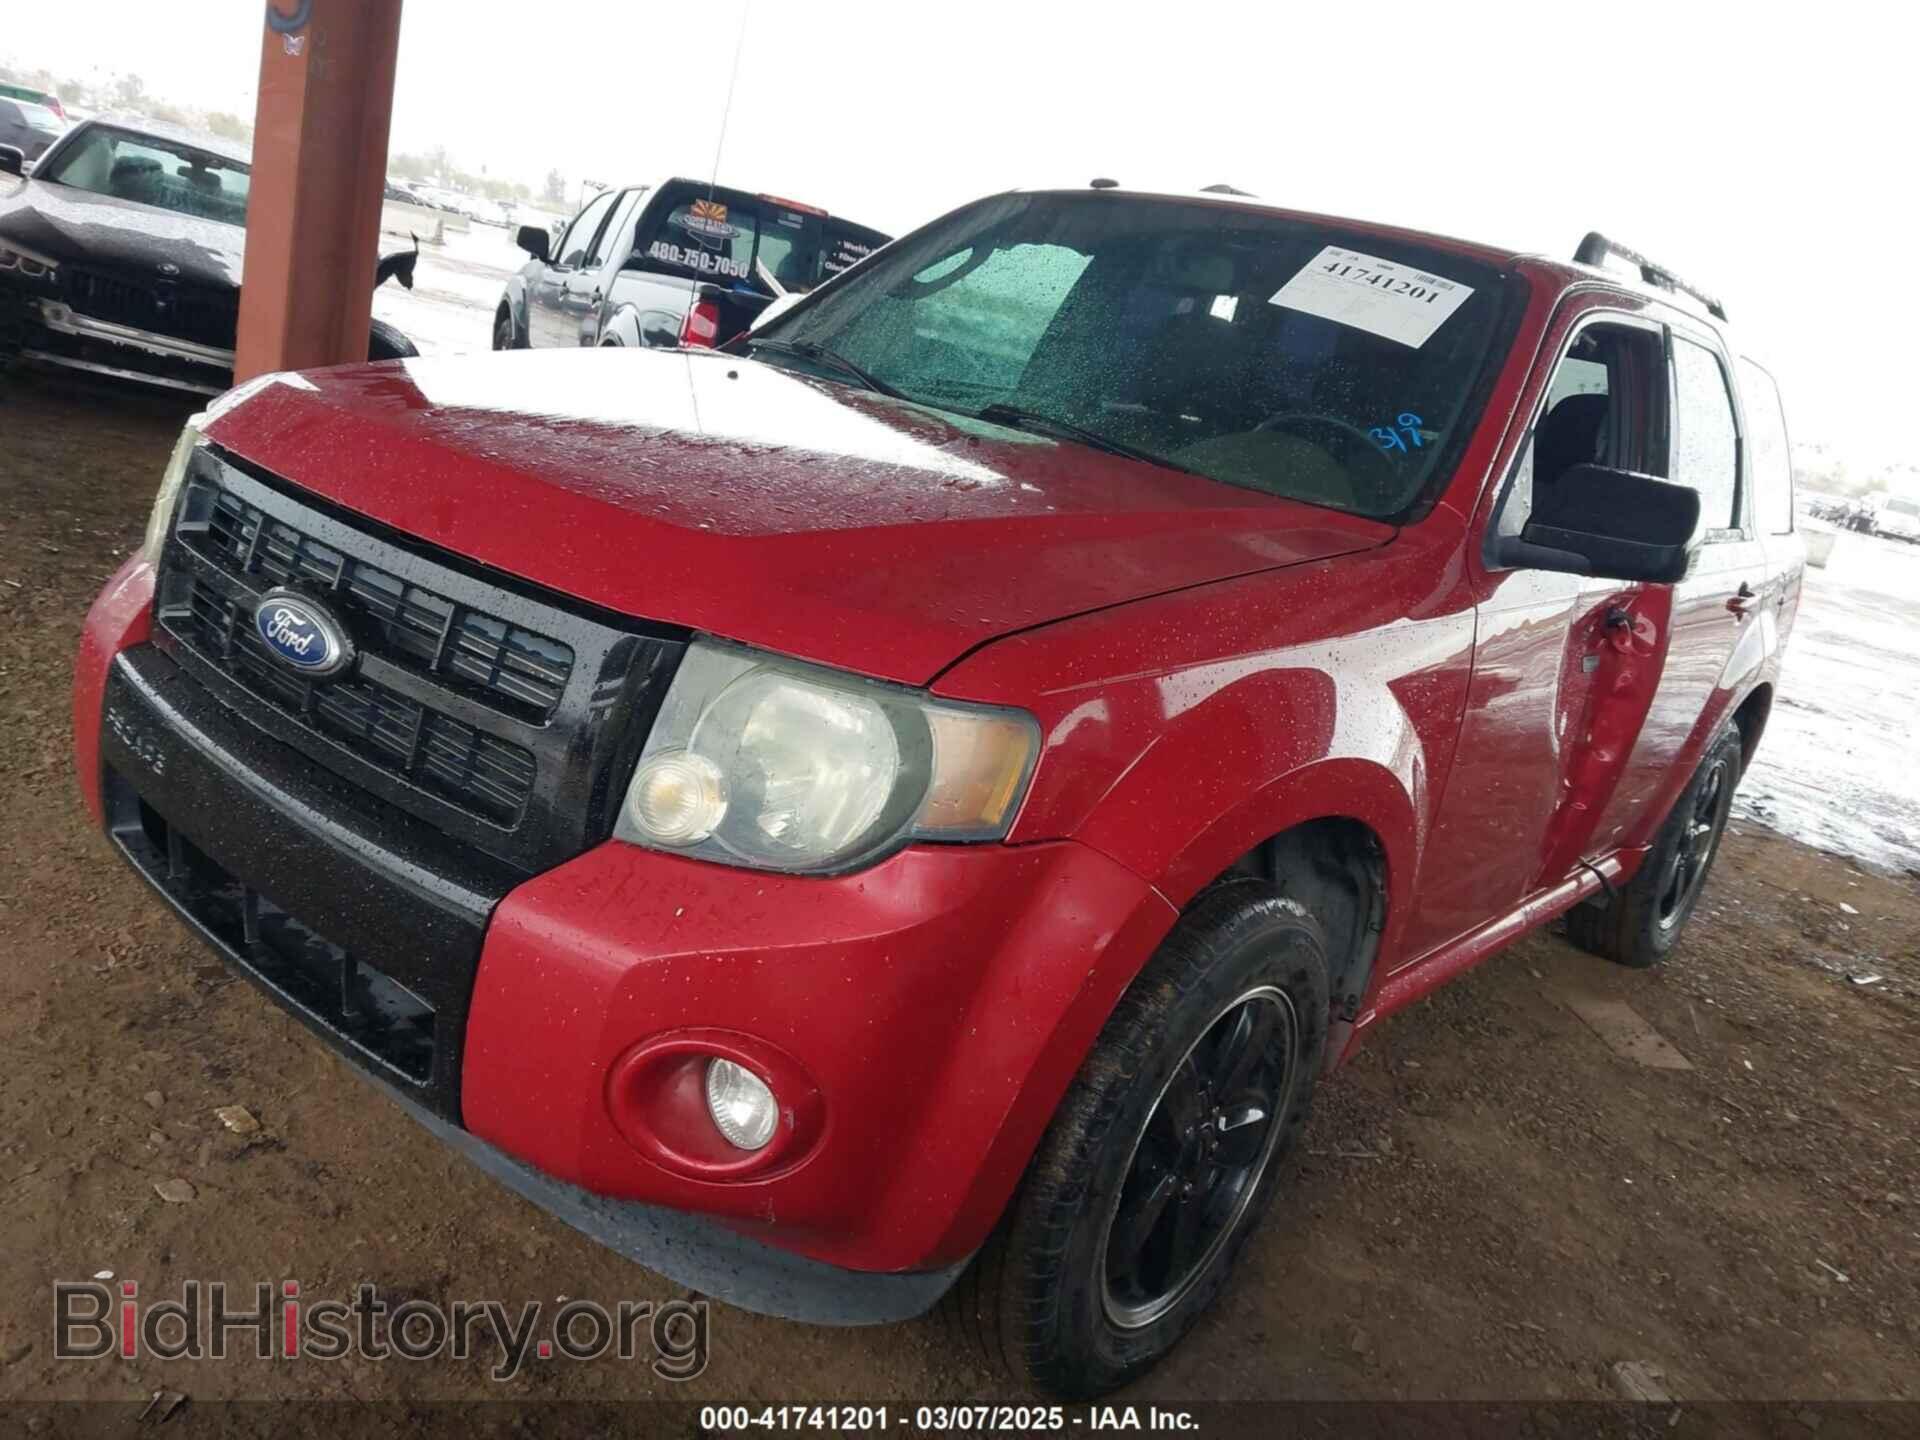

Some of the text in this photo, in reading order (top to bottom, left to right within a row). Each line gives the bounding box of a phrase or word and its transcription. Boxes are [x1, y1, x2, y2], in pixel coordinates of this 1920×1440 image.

[649, 240, 748, 279] 480-750-7050
[1323, 262, 1440, 304] 41741201
[267, 608, 315, 656] Ford
